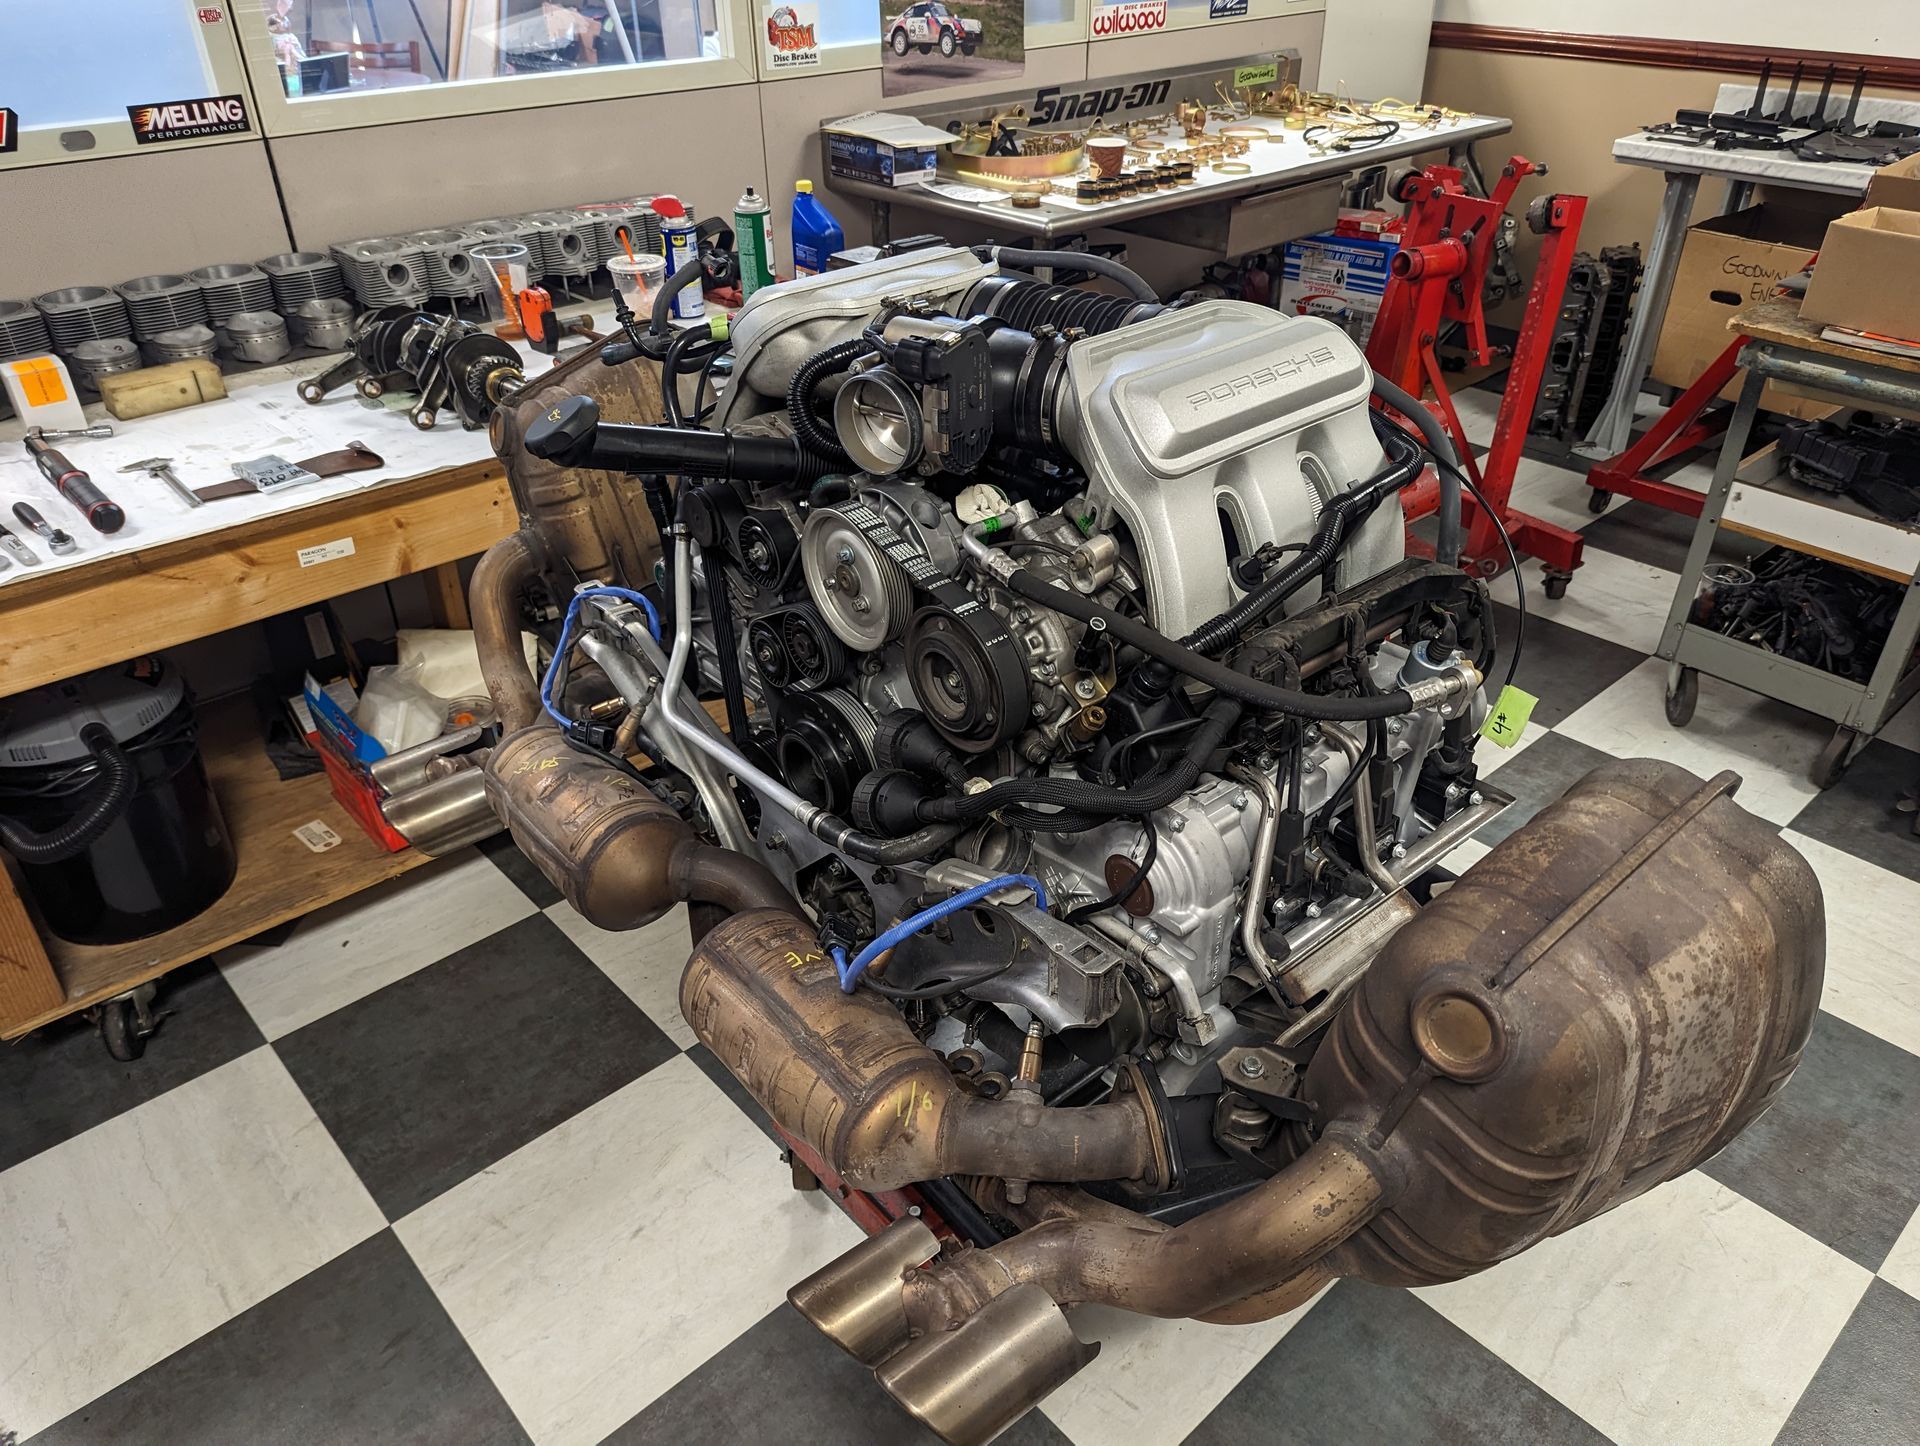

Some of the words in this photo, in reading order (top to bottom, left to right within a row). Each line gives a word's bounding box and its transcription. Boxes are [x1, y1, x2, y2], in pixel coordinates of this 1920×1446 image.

[1093, 1, 1167, 35] wilwood
[776, 24, 817, 52] TSM
[773, 54, 790, 62] Disc
[791, 53, 817, 61] Brakes
[147, 100, 243, 130] MELLING
[1027, 79, 1171, 127] Snap-on
[148, 122, 245, 139] PERFORMANCE
[1290, 298, 1333, 311] PISTONS
[1186, 346, 1336, 411] PORSCHE
[301, 547, 327, 557] PARAGON
[896, 1080, 932, 1127] 1/6
